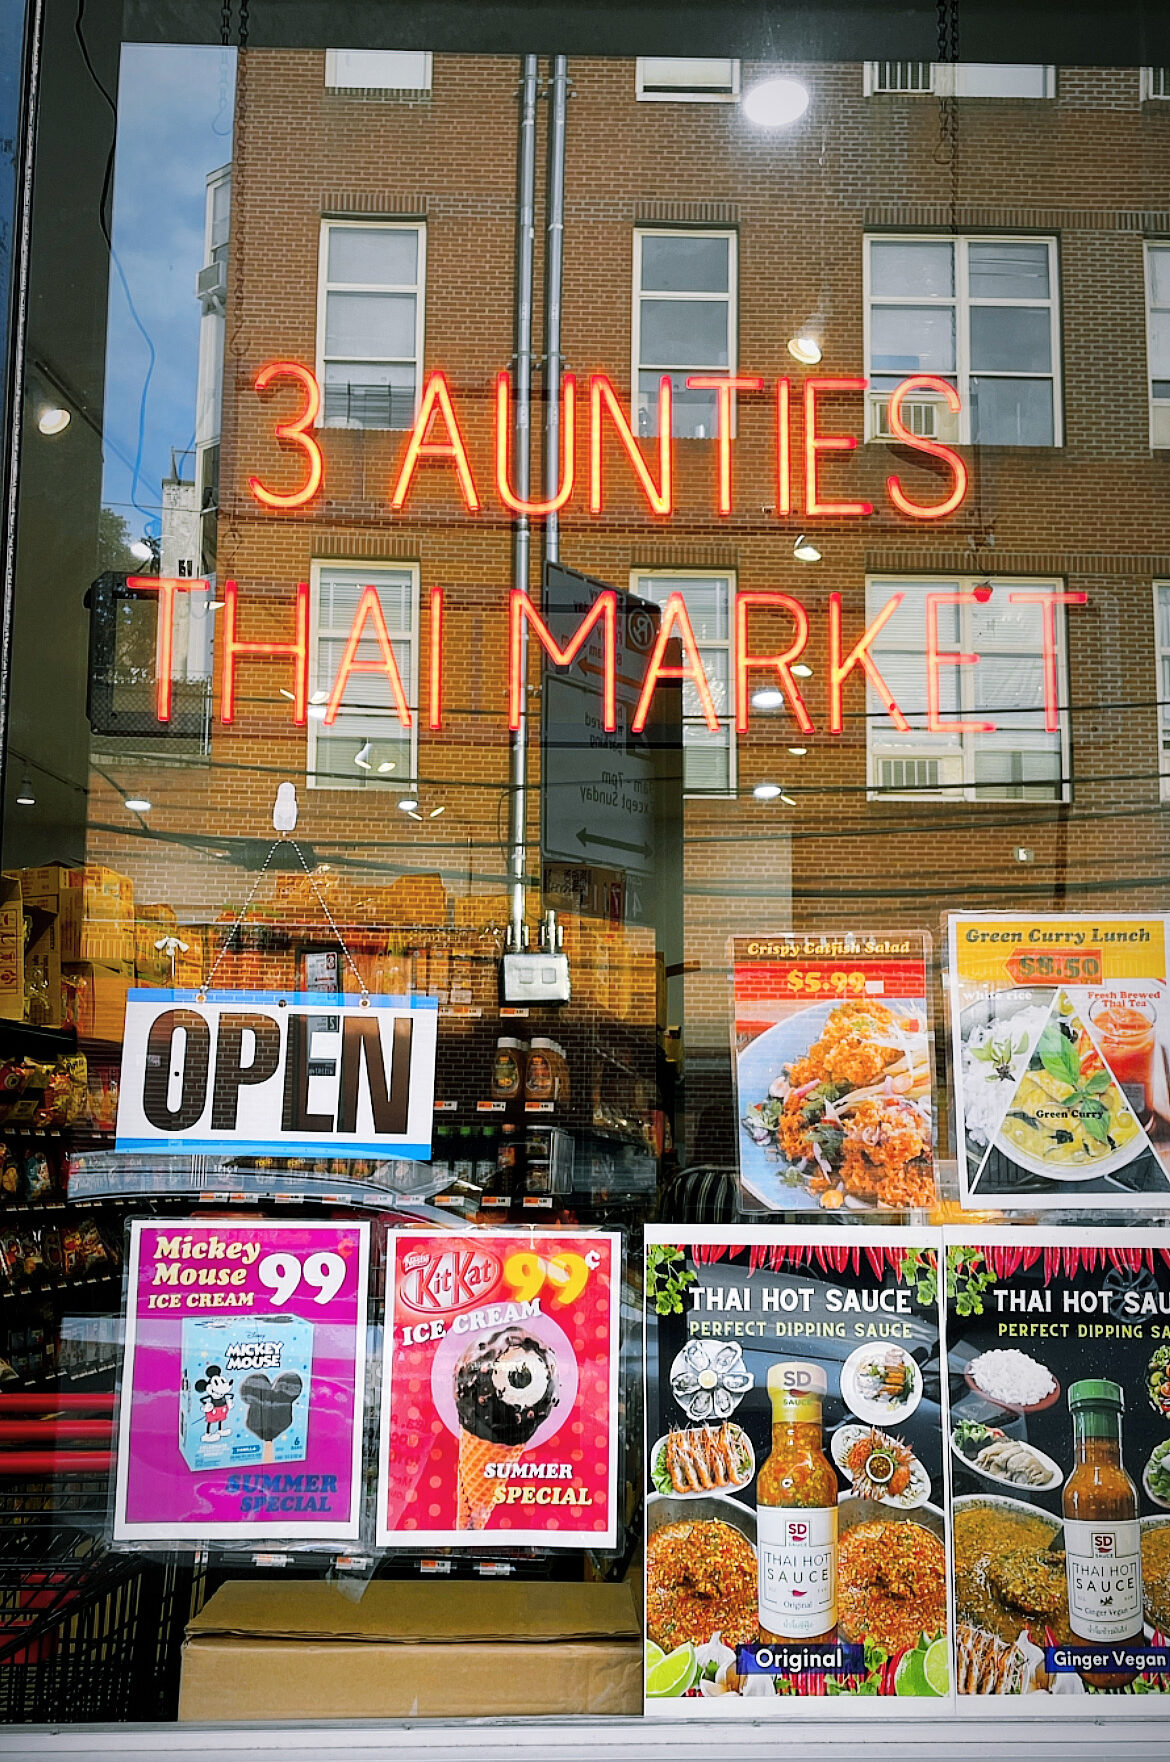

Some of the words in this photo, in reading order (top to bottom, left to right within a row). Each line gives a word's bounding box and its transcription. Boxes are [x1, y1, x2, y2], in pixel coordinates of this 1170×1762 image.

[248, 362, 325, 509] 3
[391, 370, 969, 519] AUNTIES
[126, 576, 443, 731] THAI
[508, 589, 1089, 735] MARKET
[966, 927, 1023, 944] Green
[1028, 928, 1086, 945] Curry
[1091, 928, 1151, 943] Lunch
[748, 941, 800, 957] Crispy
[803, 941, 861, 956] Catfish
[864, 940, 911, 954] Salad
[1018, 955, 1100, 979] $8.50
[786, 968, 866, 994] $5.99
[1088, 990, 1119, 1000] Fresh
[1120, 990, 1161, 1000] Brewed
[1101, 999, 1126, 1008] Thai
[1128, 999, 1148, 1008] Tea
[142, 1008, 414, 1135] OPEN
[1036, 1109, 1069, 1120] Green
[1071, 1109, 1104, 1121] Curry
[153, 1235, 261, 1266] Mickey
[152, 1262, 248, 1287] Mouse
[417, 1250, 493, 1309] KitKat
[147, 1293, 183, 1310] ICE
[186, 1292, 255, 1308] CREAM
[689, 1286, 751, 1312] THAI
[762, 1287, 814, 1313] HOT
[825, 1288, 913, 1315] SAUCE
[993, 1289, 1052, 1313] THAI
[1063, 1290, 1113, 1314] HOT
[401, 1322, 448, 1347] ICE
[452, 1297, 543, 1335] CREAM
[689, 1320, 767, 1337] PERFECT
[775, 1322, 847, 1338] DIPPING
[854, 1323, 913, 1339] SAUCE
[998, 1323, 1070, 1338] PERFECT
[1078, 1324, 1143, 1339] DIPPING
[224, 1340, 285, 1358] MICKEY
[225, 1354, 281, 1370] MOUSE
[783, 1370, 812, 1387] SD
[483, 1462, 574, 1480] SUMMER
[225, 1473, 339, 1494] SUMMER
[240, 1495, 332, 1514] SPECIAL
[492, 1486, 593, 1506] SPECIAL
[788, 1523, 807, 1535] SD
[1094, 1535, 1113, 1547] SD
[766, 1552, 797, 1568] THAI
[803, 1552, 832, 1566] HOT
[767, 1568, 829, 1584] SAUCE
[1075, 1563, 1104, 1577] THAI
[1110, 1563, 1136, 1576] HOT
[1076, 1577, 1135, 1593] SAUCE
[755, 1648, 844, 1673] Original
[1053, 1649, 1110, 1672] Ginger
[1111, 1651, 1167, 1671] Vegan
